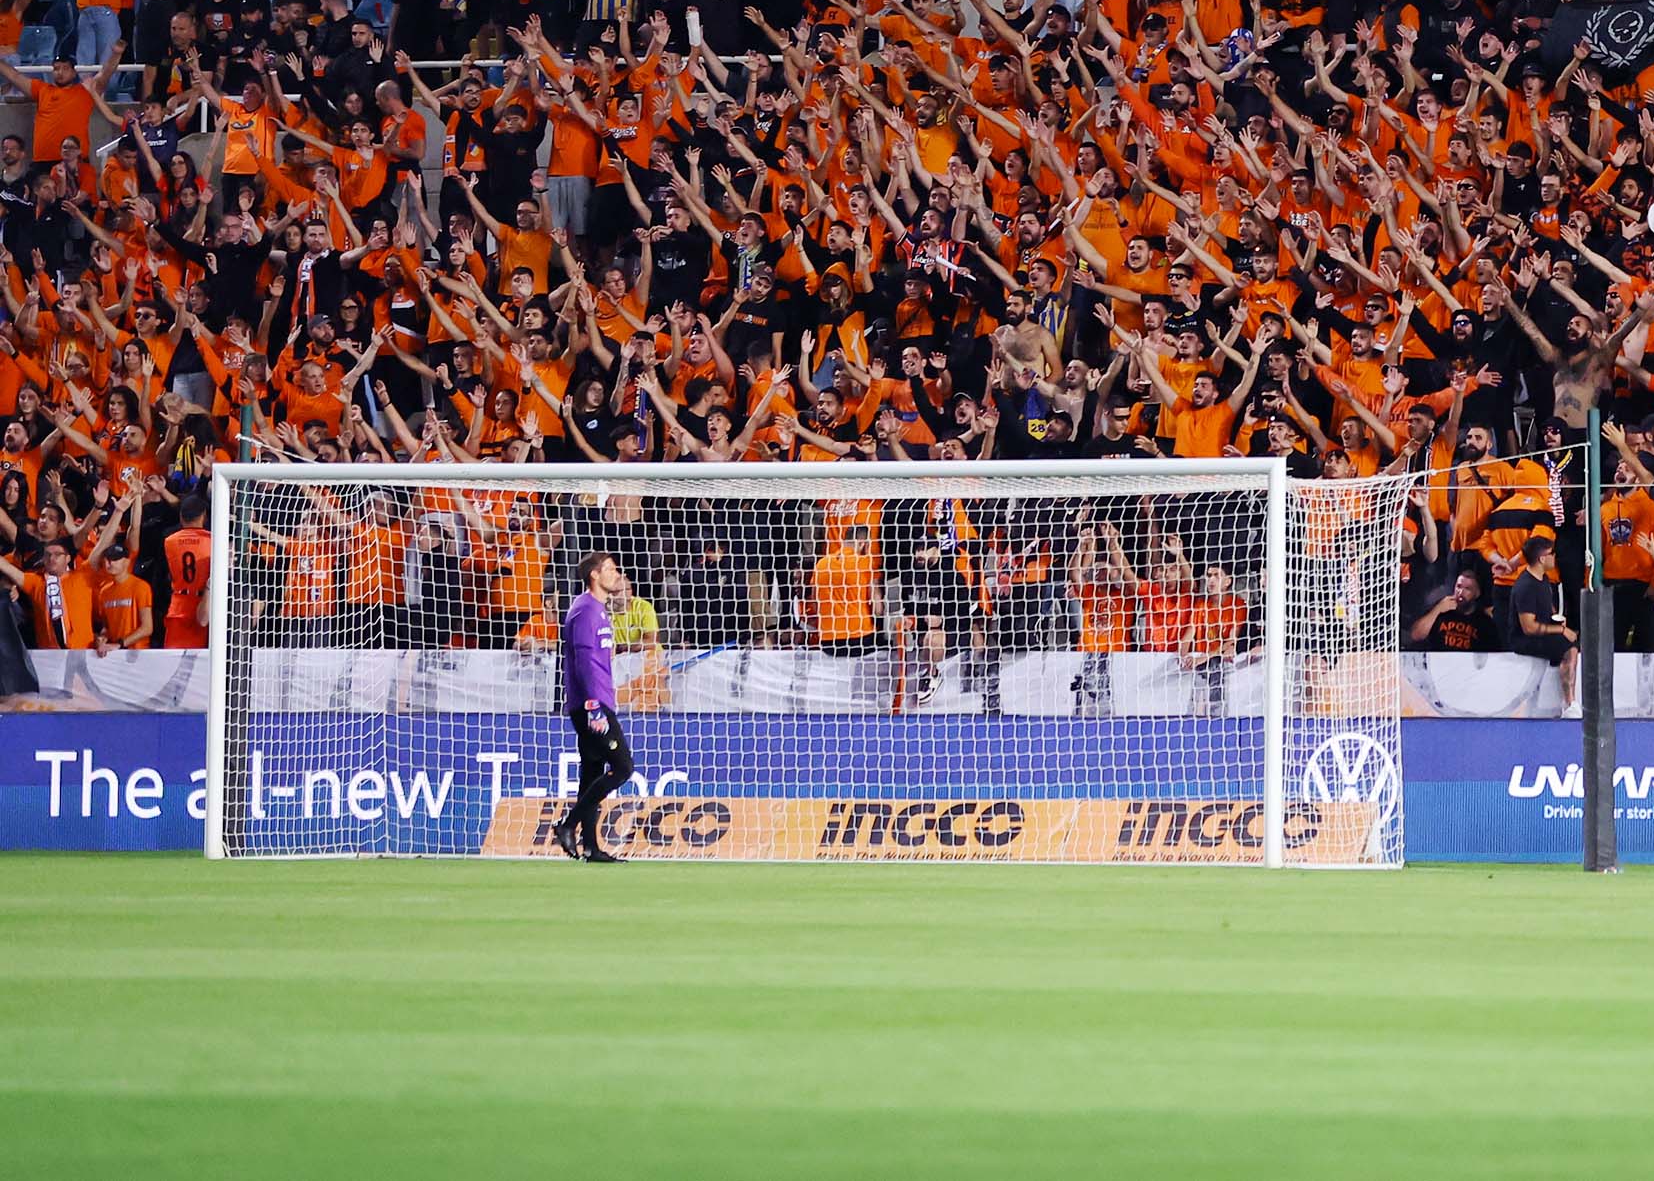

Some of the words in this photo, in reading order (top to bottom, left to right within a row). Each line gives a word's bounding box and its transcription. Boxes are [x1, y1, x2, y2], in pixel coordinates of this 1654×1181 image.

[1030, 423, 1046, 433] 28
[182, 550, 197, 583] 8
[35, 749, 163, 818] The
[186, 750, 454, 819] al-new
